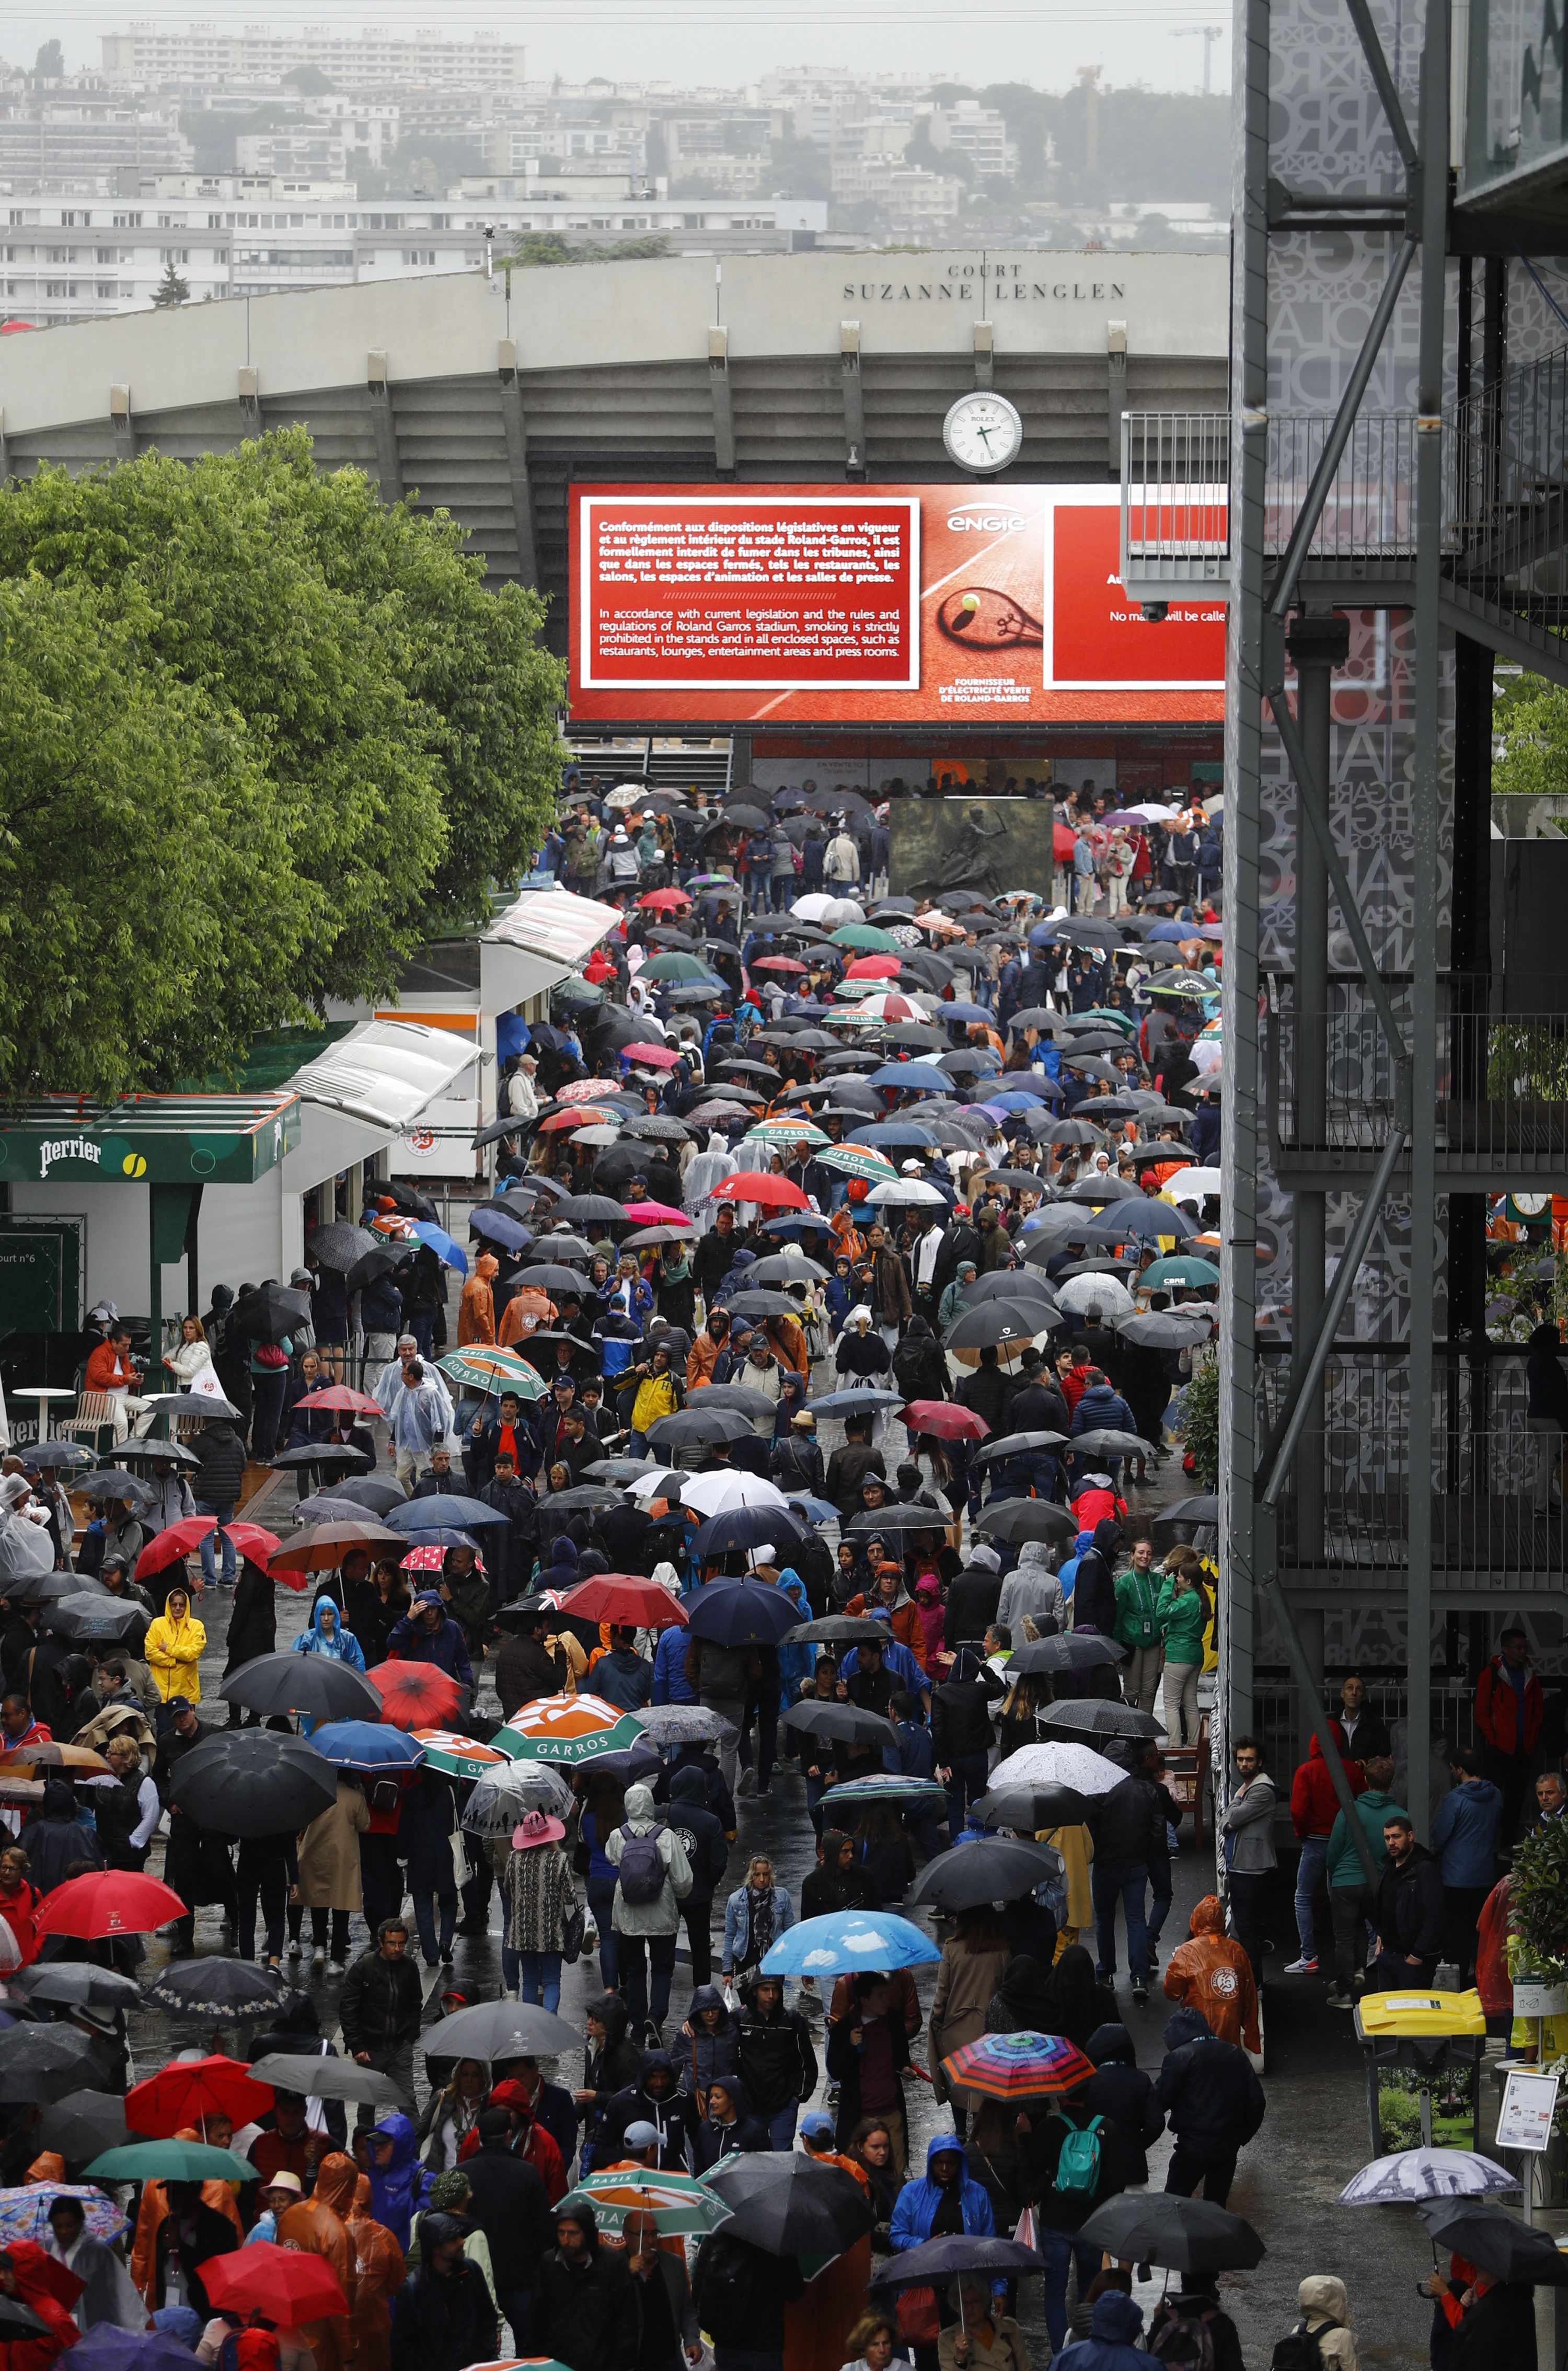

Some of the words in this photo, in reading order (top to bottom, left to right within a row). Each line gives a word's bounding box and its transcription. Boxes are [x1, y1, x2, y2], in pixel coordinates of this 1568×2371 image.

[948, 264, 1022, 277] COURT
[843, 284, 973, 300] SUZANNE
[995, 283, 1127, 300] LENGLEN
[598, 521, 683, 532] Conformément
[684, 524, 706, 532] aux
[707, 521, 774, 534] dispositions
[776, 521, 838, 534] législatives
[840, 524, 855, 533] en
[857, 522, 901, 534] vigueur
[598, 535, 612, 547] et
[613, 536, 628, 545] au
[629, 533, 686, 547] règlement
[688, 532, 736, 545] intérieur
[737, 534, 753, 545] du
[755, 534, 785, 545] stade
[787, 532, 871, 547] Roland-Garros,
[873, 532, 881, 545] il
[882, 536, 901, 545] est
[598, 545, 674, 557] formellement
[676, 546, 719, 557] interdit
[720, 546, 735, 557] de
[737, 546, 771, 557] fumer
[773, 546, 800, 557] dans
[803, 546, 820, 557] les
[822, 546, 871, 559] tribunes,
[873, 547, 900, 558] ainsi
[598, 561, 620, 571] que
[624, 558, 651, 569] dans
[655, 558, 672, 569] les
[676, 561, 719, 572] espaces
[722, 559, 764, 571] fermés,
[768, 559, 789, 570] tels
[793, 559, 810, 570] les
[814, 560, 879, 572] restaurants,
[883, 559, 900, 570] les
[599, 571, 638, 583] salons,
[640, 571, 656, 582] les
[659, 574, 701, 584] espaces
[704, 571, 769, 582] d'animation
[772, 572, 785, 582] et
[787, 571, 803, 582] les
[805, 571, 837, 582] salles
[838, 571, 854, 582] de
[856, 574, 894, 584] presse.
[599, 608, 609, 618] In
[614, 608, 674, 619] accordance
[677, 608, 700, 619] with
[704, 609, 742, 619] current
[746, 608, 799, 621] legislation
[803, 609, 824, 619] and
[827, 609, 846, 619] the
[850, 609, 875, 619] rules
[879, 609, 900, 619] and
[1109, 611, 1127, 621] No
[1184, 611, 1199, 621] be
[1201, 611, 1226, 621] calle
[599, 620, 657, 634] regulations
[661, 620, 672, 631] of
[676, 620, 712, 631] Roland
[716, 621, 752, 631] Garros
[755, 620, 800, 633] stadium,
[804, 621, 849, 634] smoking
[852, 621, 861, 631] is
[864, 621, 900, 634] strictly
[599, 633, 652, 645] prohibited
[654, 634, 664, 643] in
[666, 633, 684, 643] the
[686, 633, 720, 643] stands
[721, 633, 742, 644] and
[744, 634, 754, 643] in
[756, 634, 769, 644] all
[771, 634, 819, 644] enclosed
[821, 636, 859, 646] spaces,
[861, 634, 886, 644] such
[887, 636, 900, 644] as
[599, 647, 659, 658] restaurants,
[661, 646, 706, 658] lounges,
[708, 646, 781, 656] entertainment
[813, 646, 833, 656] and
[835, 648, 862, 658] press
[864, 648, 900, 657] rooms.
[954, 678, 1016, 686] FOURNISSEUR
[939, 685, 1001, 695] D'ÉLECTRICITÉ
[940, 695, 953, 703] DE
[954, 695, 1030, 703] ROLAND-GARROS
[826, 1150, 866, 1165] GARROS
[19, 1254, 36, 1263] n°6
[660, 1382, 672, 1391] H
[1052, 1637, 1071, 1664] REPLAY
[536, 1736, 609, 1756] GARROS
[683, 1831, 696, 1850] GARROS
[592, 2174, 631, 2184] PARIS
